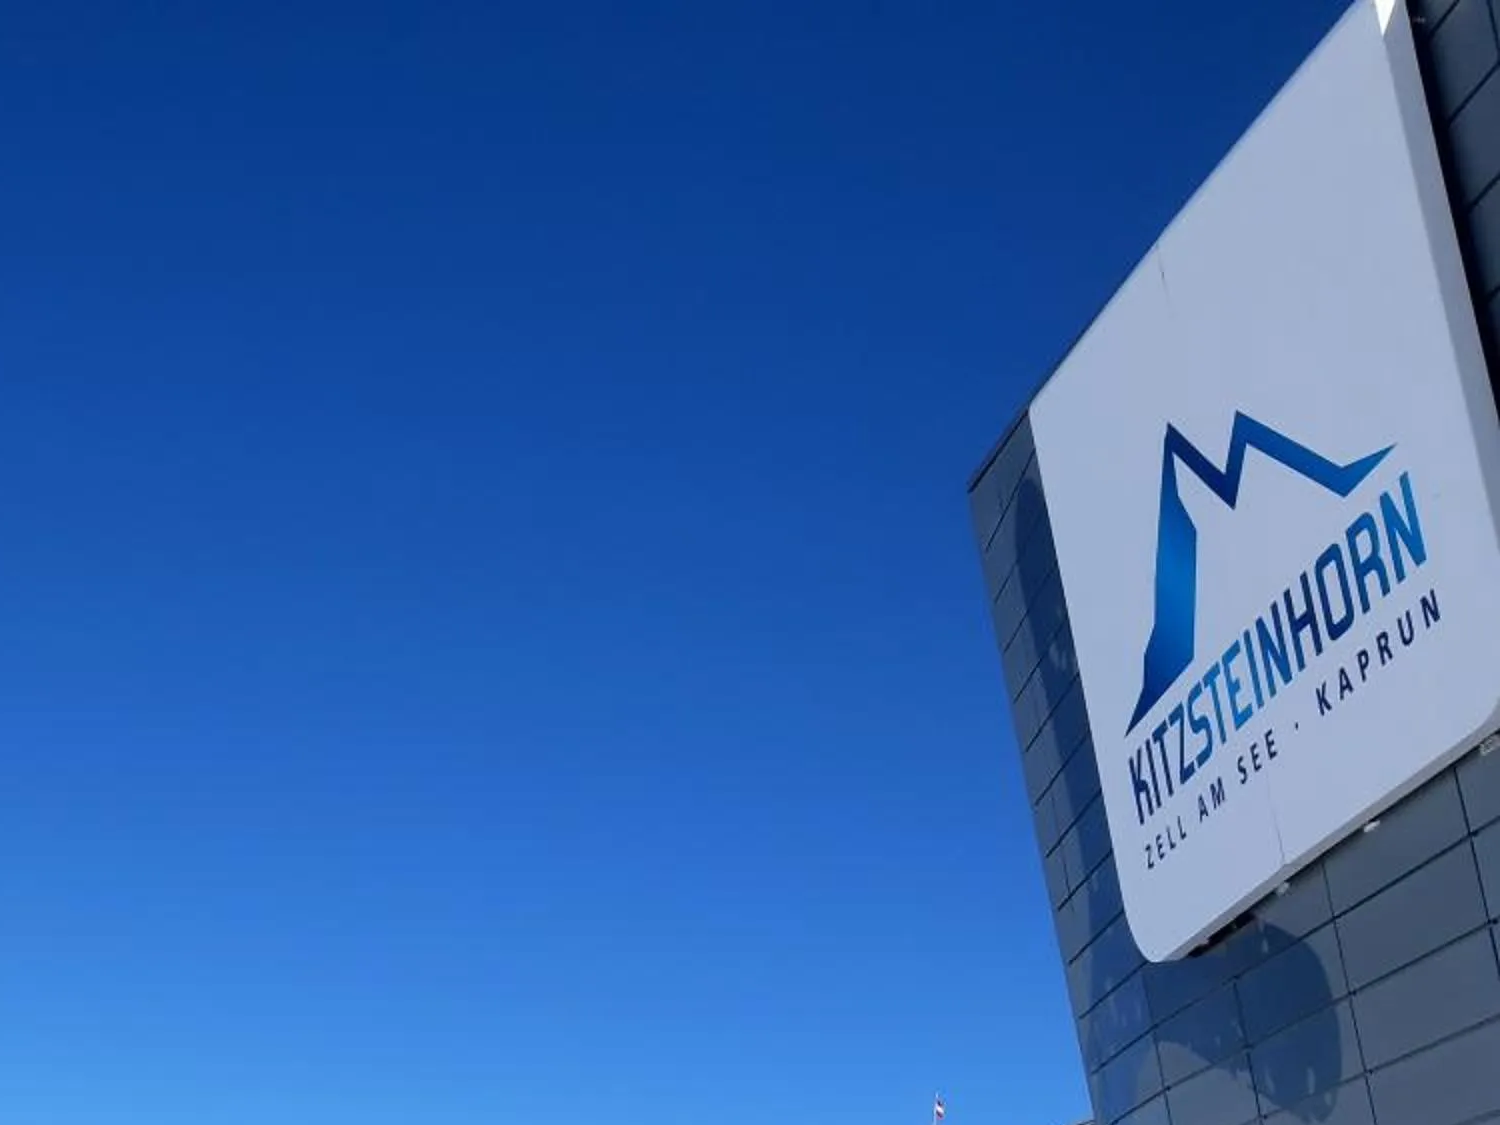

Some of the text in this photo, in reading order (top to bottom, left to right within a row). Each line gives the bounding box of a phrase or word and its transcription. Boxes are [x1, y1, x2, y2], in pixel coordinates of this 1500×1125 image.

[1128, 470, 1428, 826] KITZSTEINHORN
[1144, 588, 1441, 870] ZELL AM SEE KAPRUN
